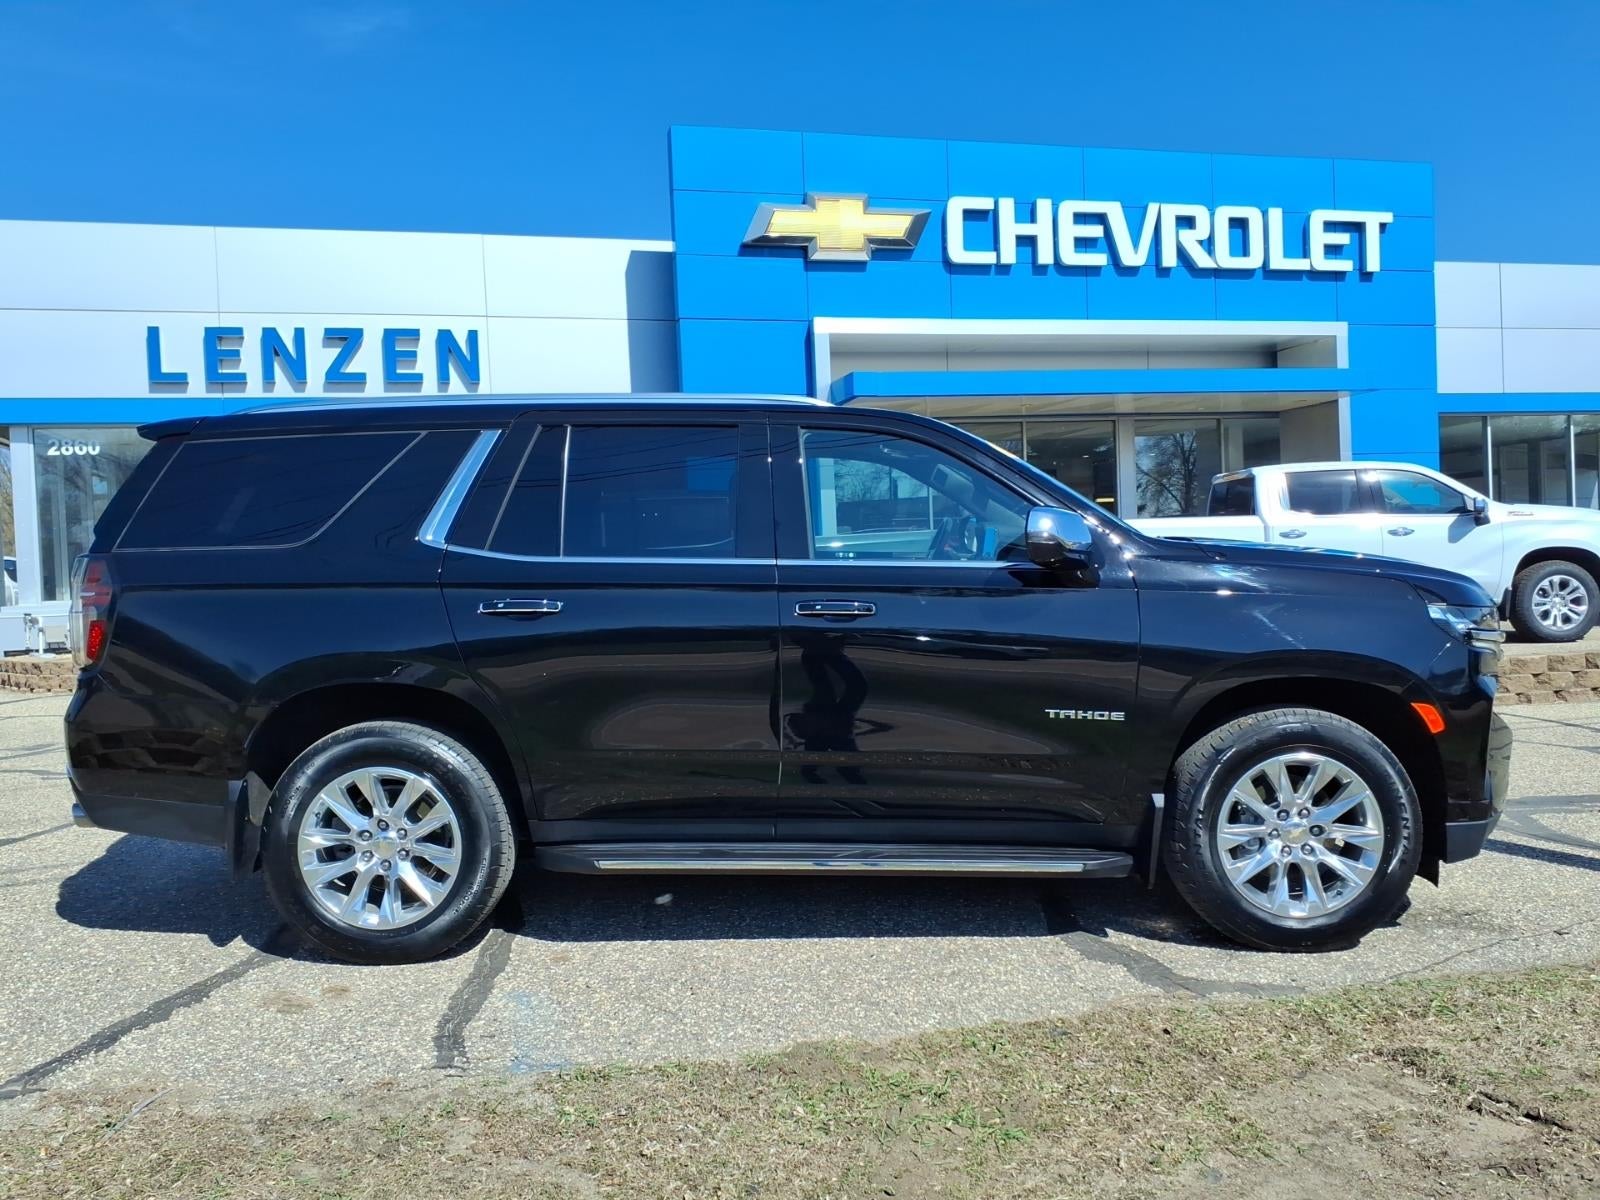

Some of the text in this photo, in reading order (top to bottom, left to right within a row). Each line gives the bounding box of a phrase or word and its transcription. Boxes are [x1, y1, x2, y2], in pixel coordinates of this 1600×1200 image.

[945, 195, 1394, 273] CHEVROLET
[146, 326, 481, 384] LENZEN
[47, 438, 101, 456] 2860
[1044, 709, 1126, 721] TAHOE
